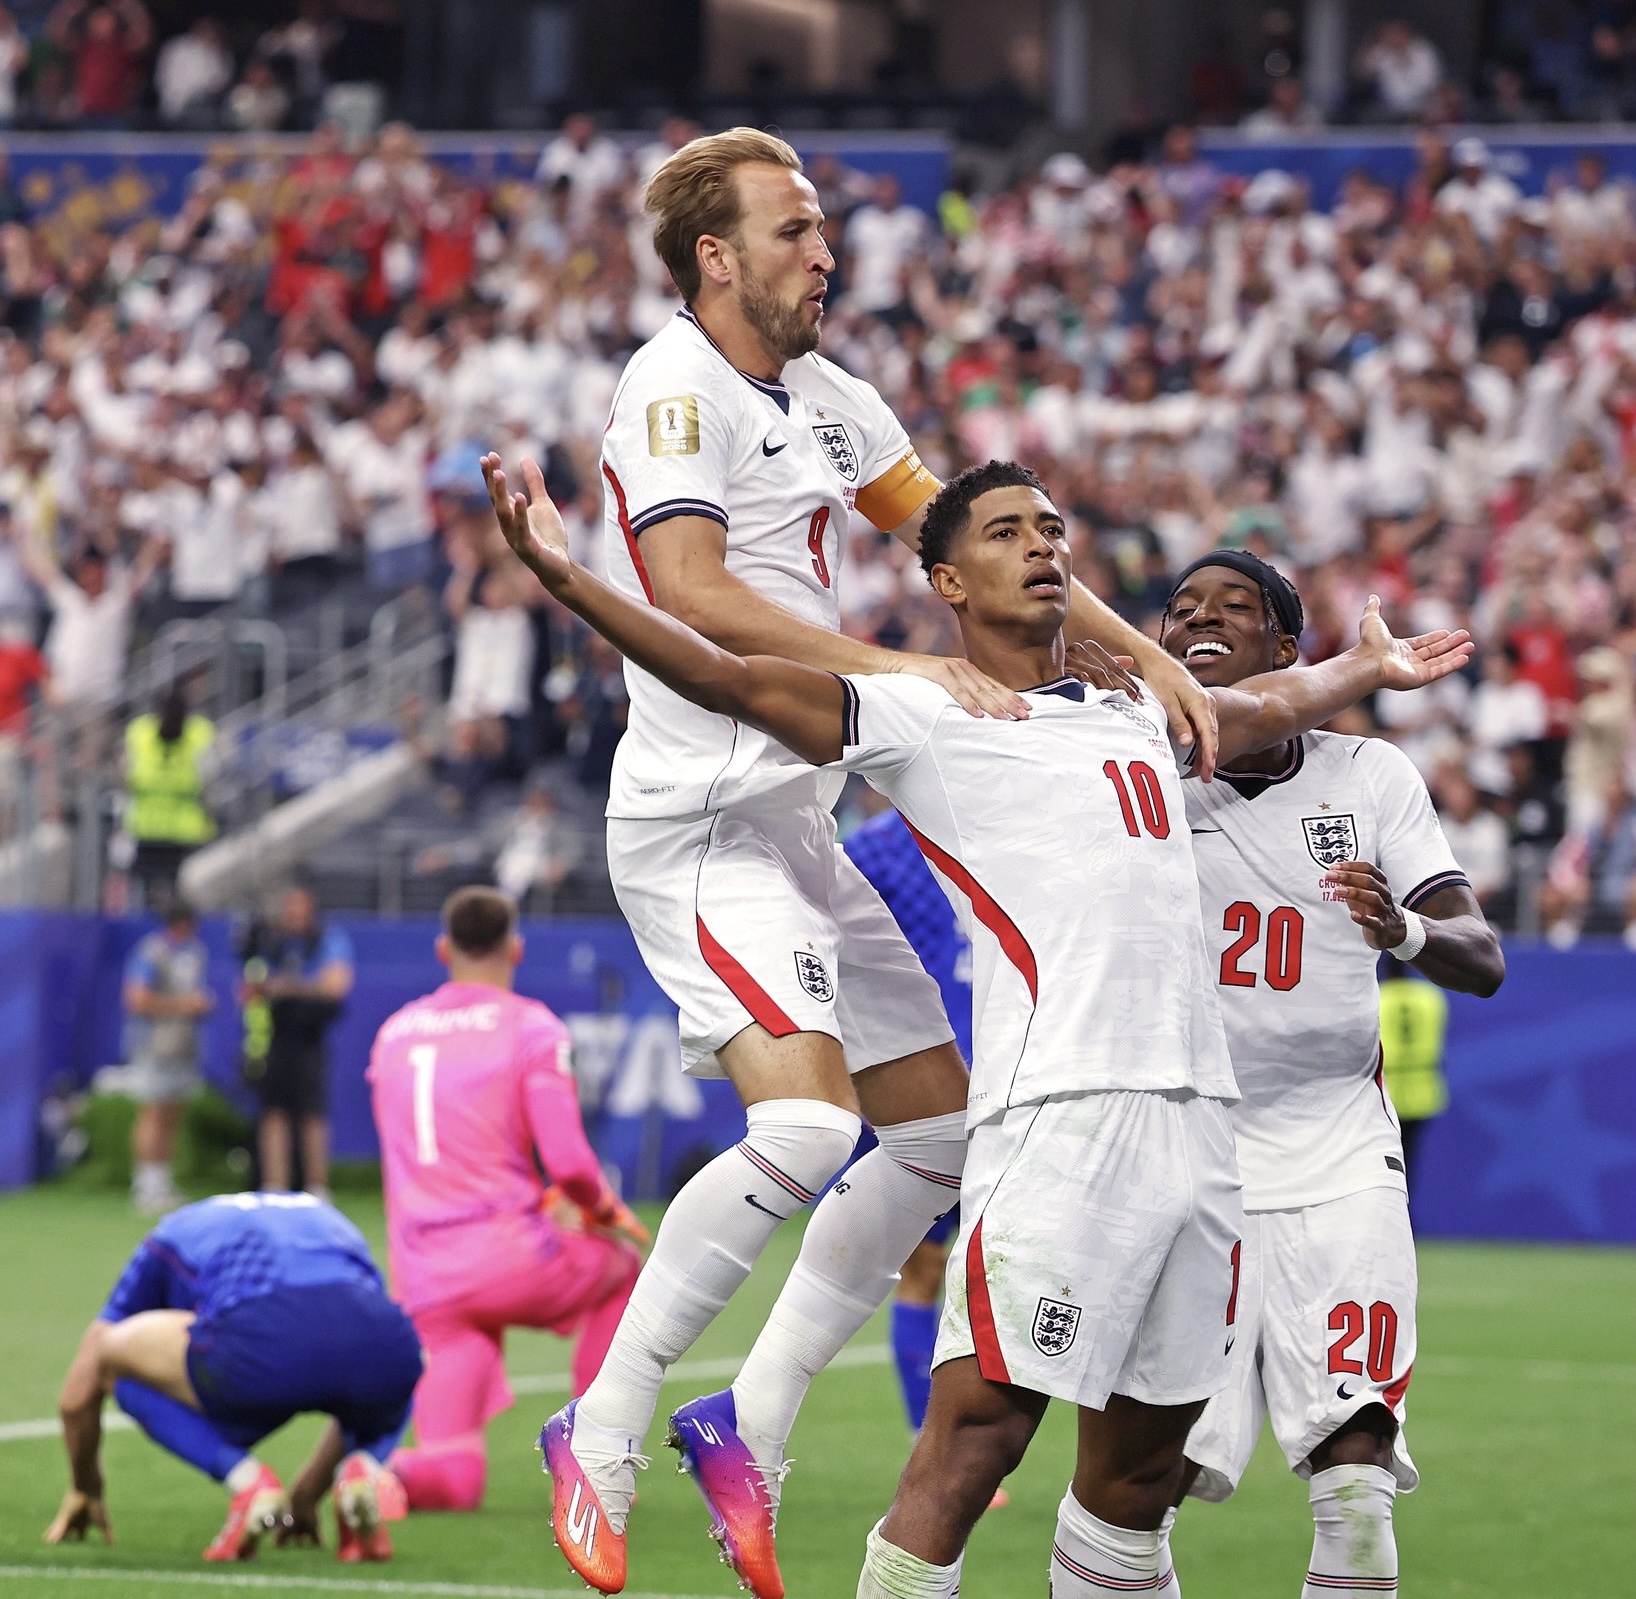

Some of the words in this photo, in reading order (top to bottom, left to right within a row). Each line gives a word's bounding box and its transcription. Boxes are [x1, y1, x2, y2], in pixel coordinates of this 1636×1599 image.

[807, 506, 830, 589] 9
[1102, 760, 1171, 840] 10
[1219, 901, 1304, 992] 20
[406, 1044, 438, 1166] 1
[1328, 1300, 1398, 1383] 20
